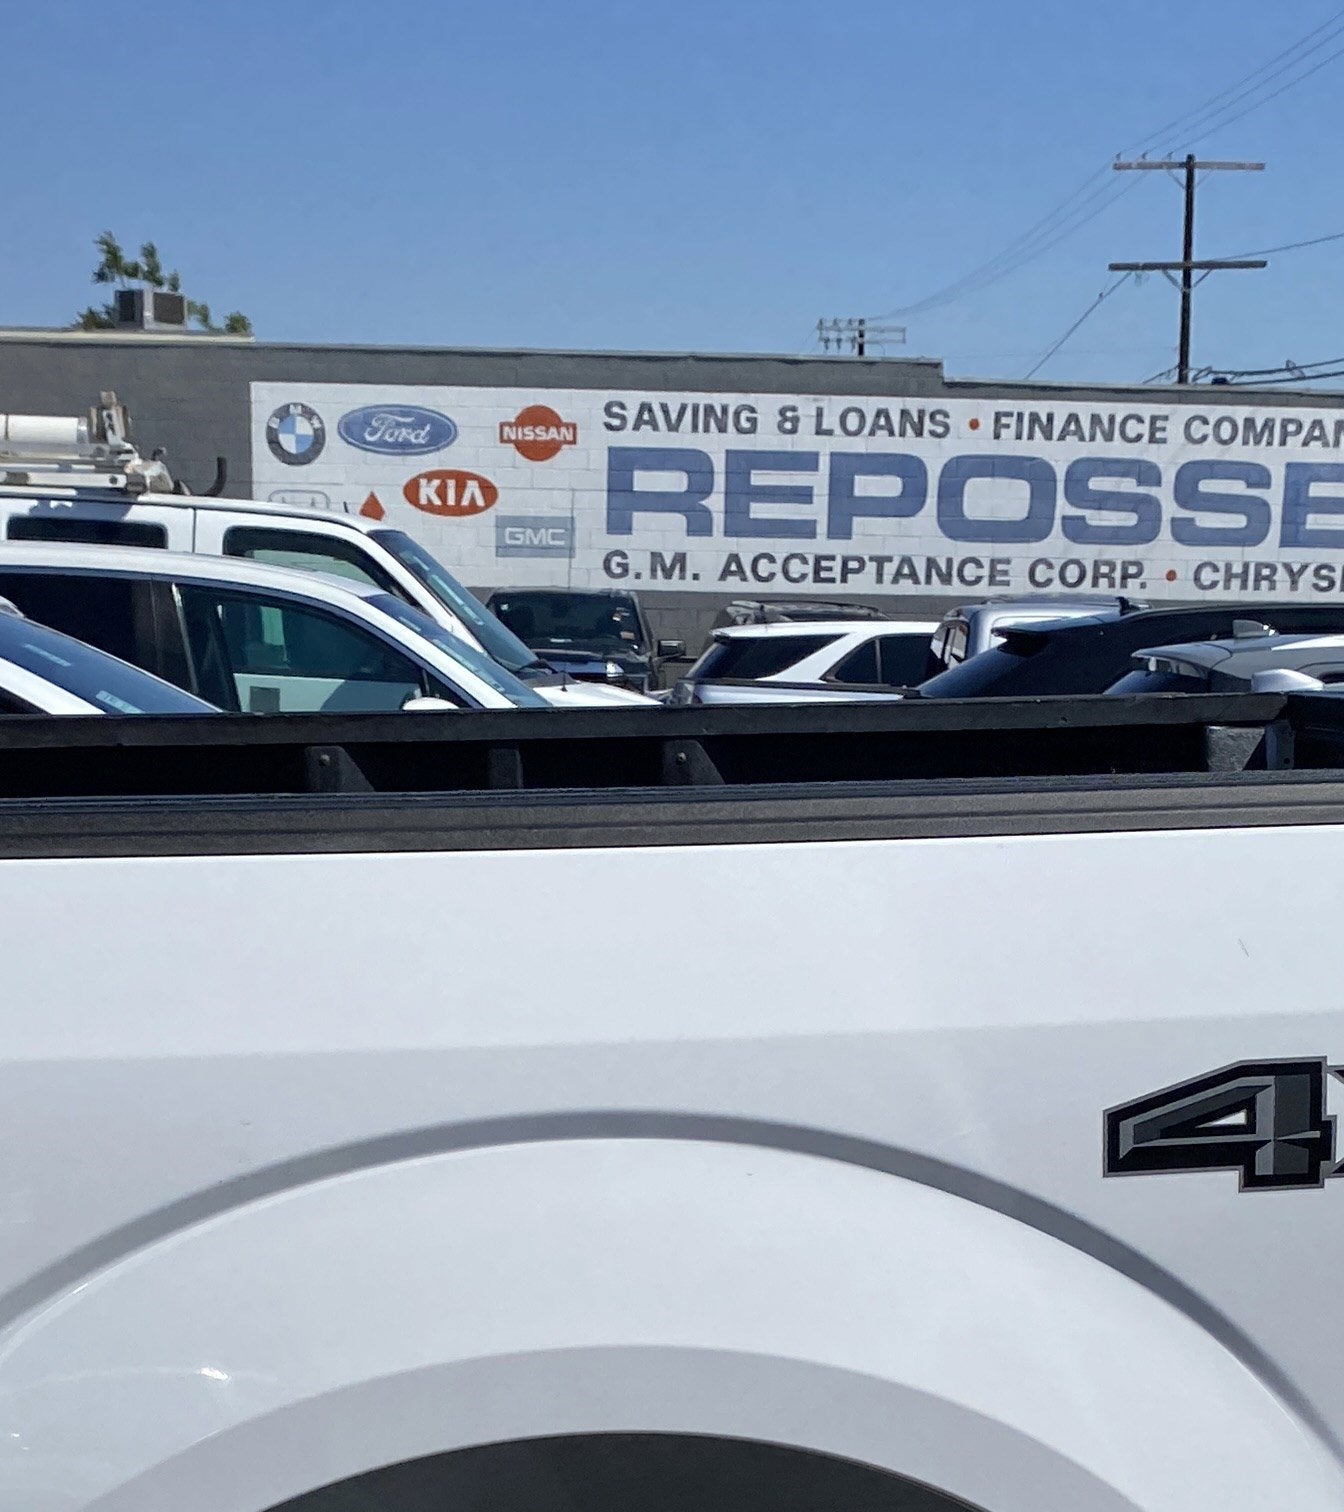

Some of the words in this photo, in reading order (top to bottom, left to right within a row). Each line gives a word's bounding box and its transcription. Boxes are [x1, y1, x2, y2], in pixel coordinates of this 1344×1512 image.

[363, 412, 430, 445] Ford
[504, 424, 574, 441] NISSAN
[604, 400, 759, 434] SAVING
[777, 405, 801, 436] &
[816, 406, 952, 439] LOANS
[992, 411, 1170, 444] FINANCE
[417, 478, 485, 507] KIA
[506, 527, 566, 546] GMC
[603, 551, 700, 582] G.M.
[717, 552, 1011, 587] ACCEPTANCE
[1027, 556, 1148, 590] CORP.
